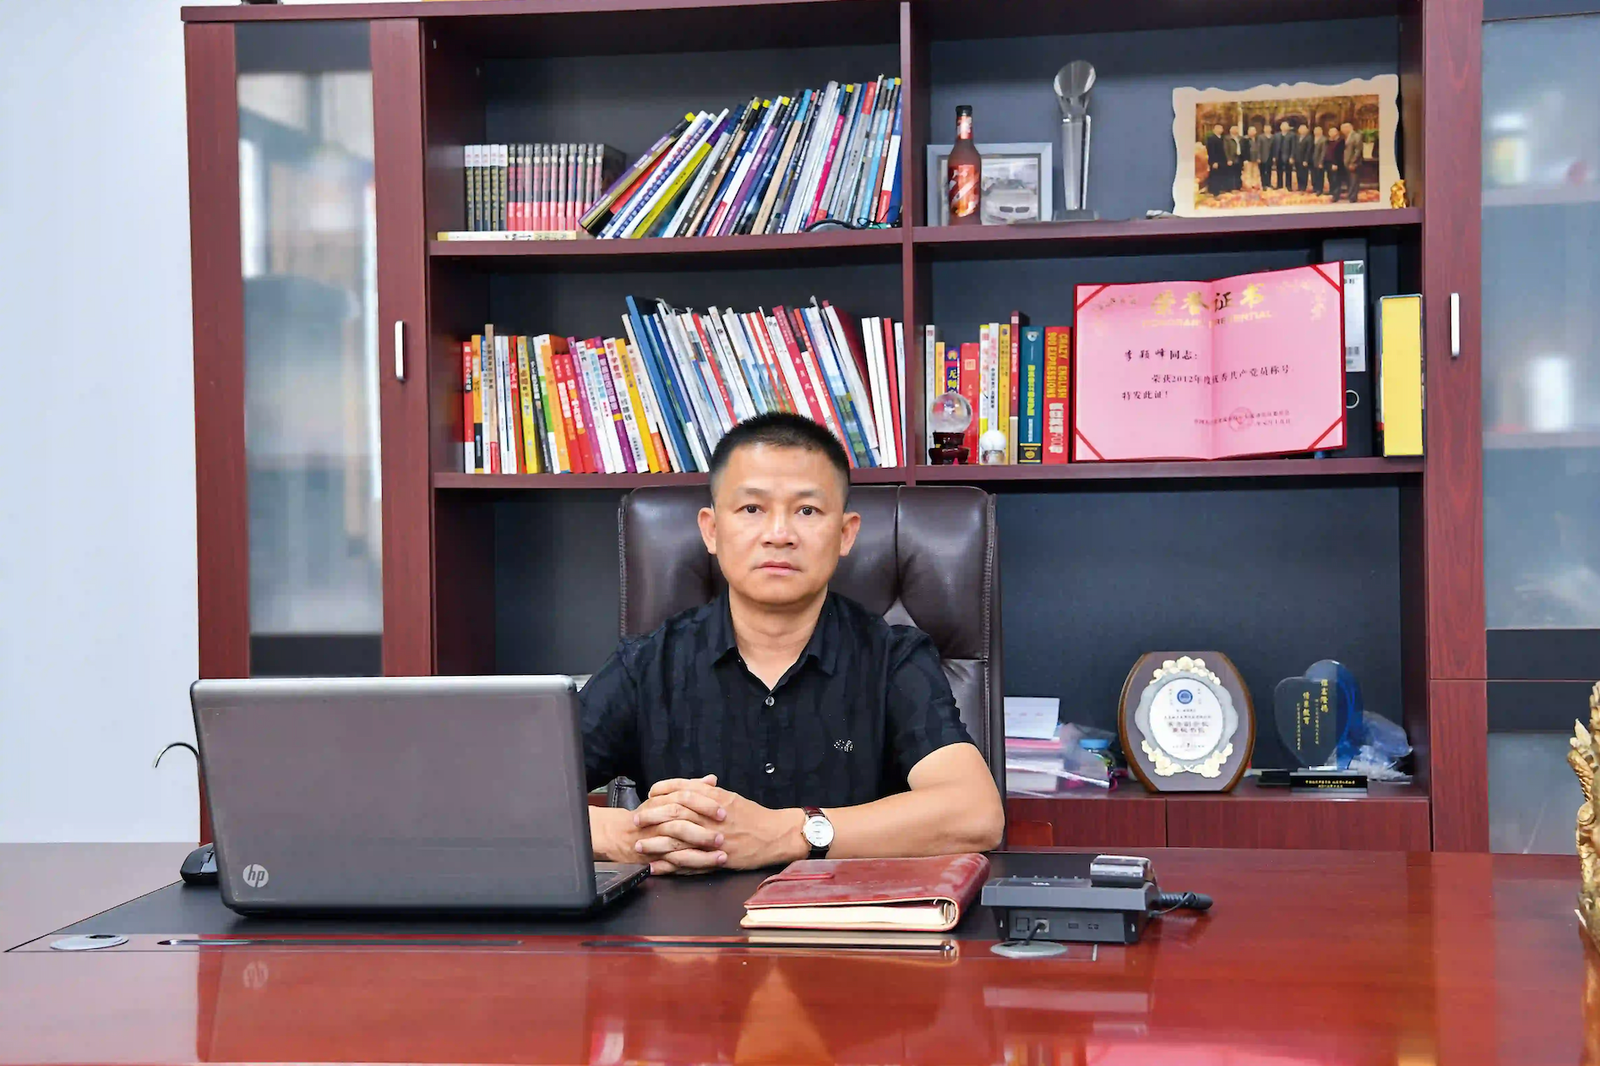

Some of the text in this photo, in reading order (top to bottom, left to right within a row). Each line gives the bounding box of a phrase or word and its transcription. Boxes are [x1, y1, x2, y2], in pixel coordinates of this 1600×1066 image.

[1057, 333, 1068, 399] CRAZY ENGLISH
[245, 864, 267, 888] hp
